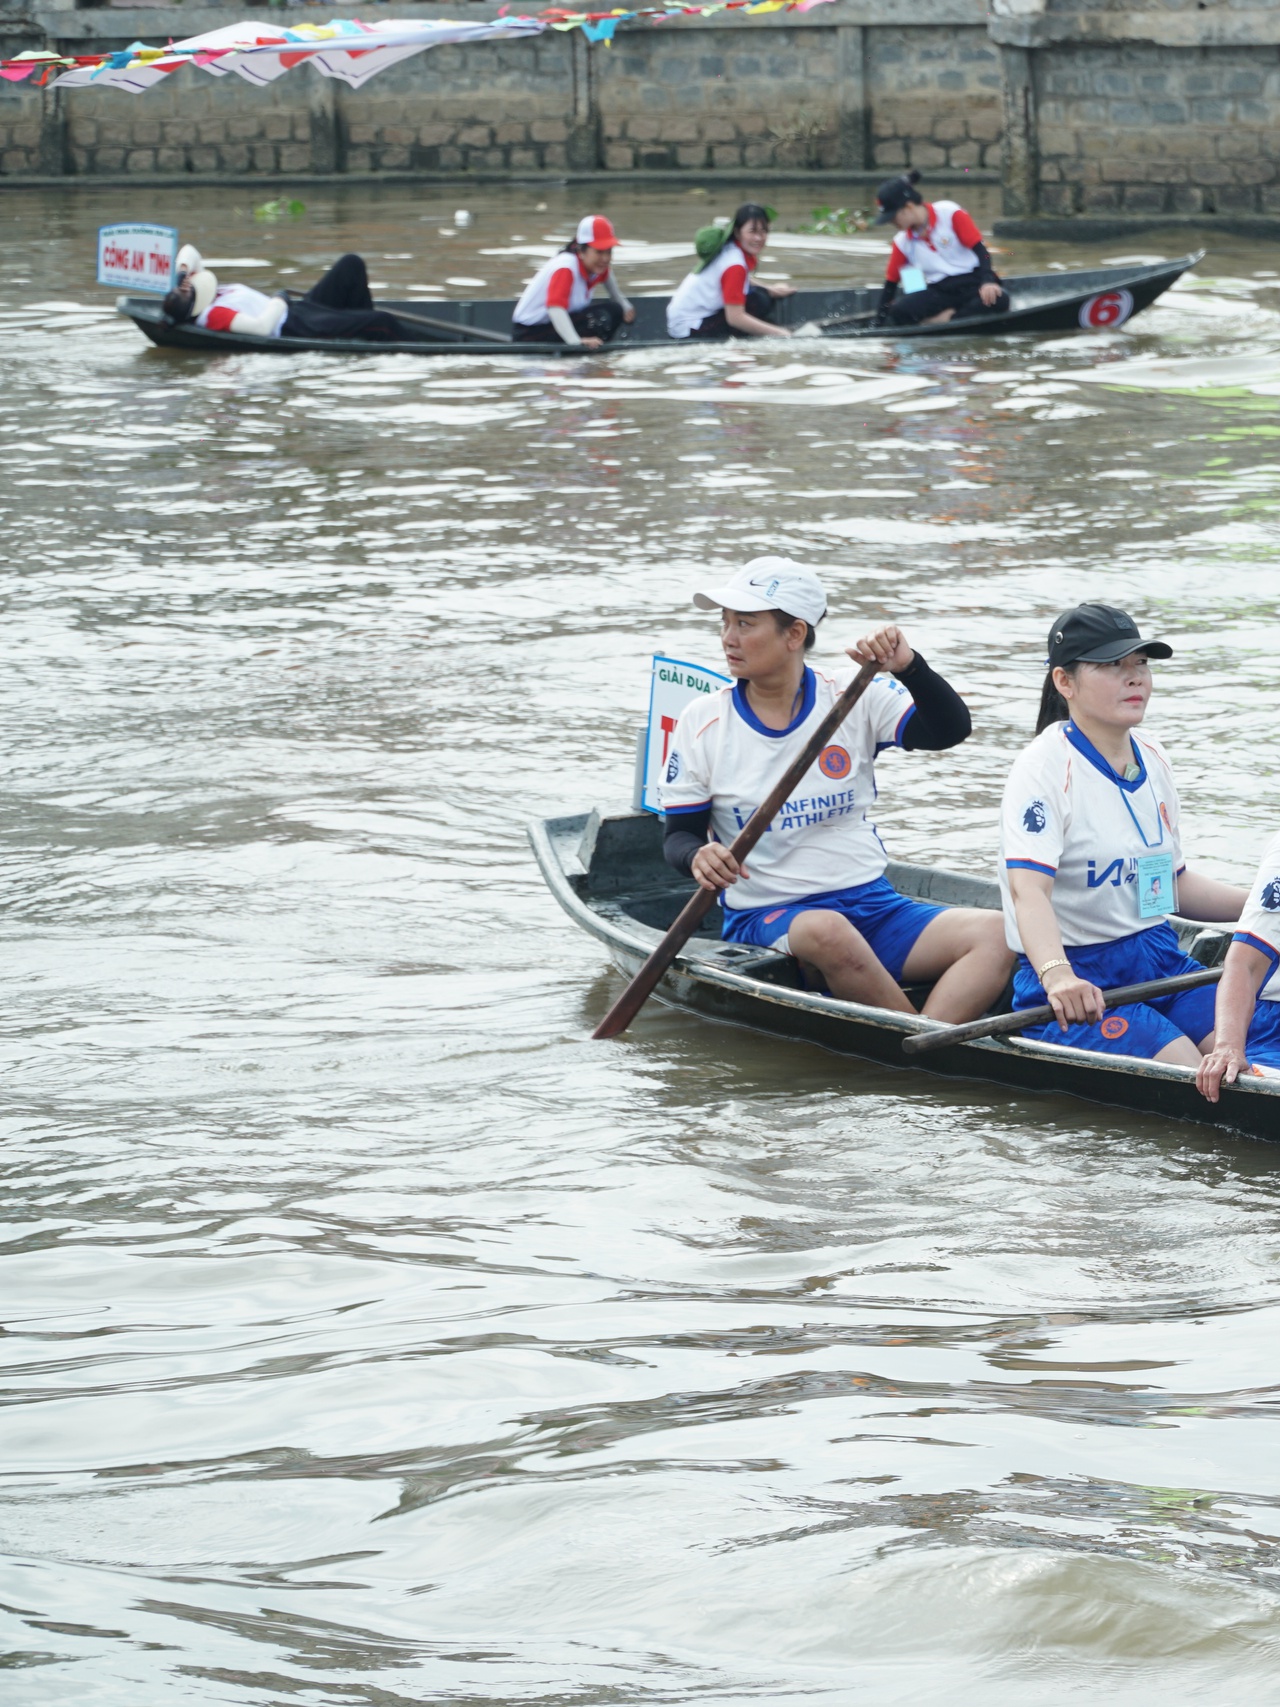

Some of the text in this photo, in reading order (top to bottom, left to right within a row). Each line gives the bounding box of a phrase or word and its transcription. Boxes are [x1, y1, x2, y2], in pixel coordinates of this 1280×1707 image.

[131, 250, 145, 273] AN
[1088, 292, 1122, 327] 6
[659, 666, 711, 694] GIẢI ĐUA
[780, 789, 855, 815] INFINITE
[780, 803, 855, 831] ATHLETE
